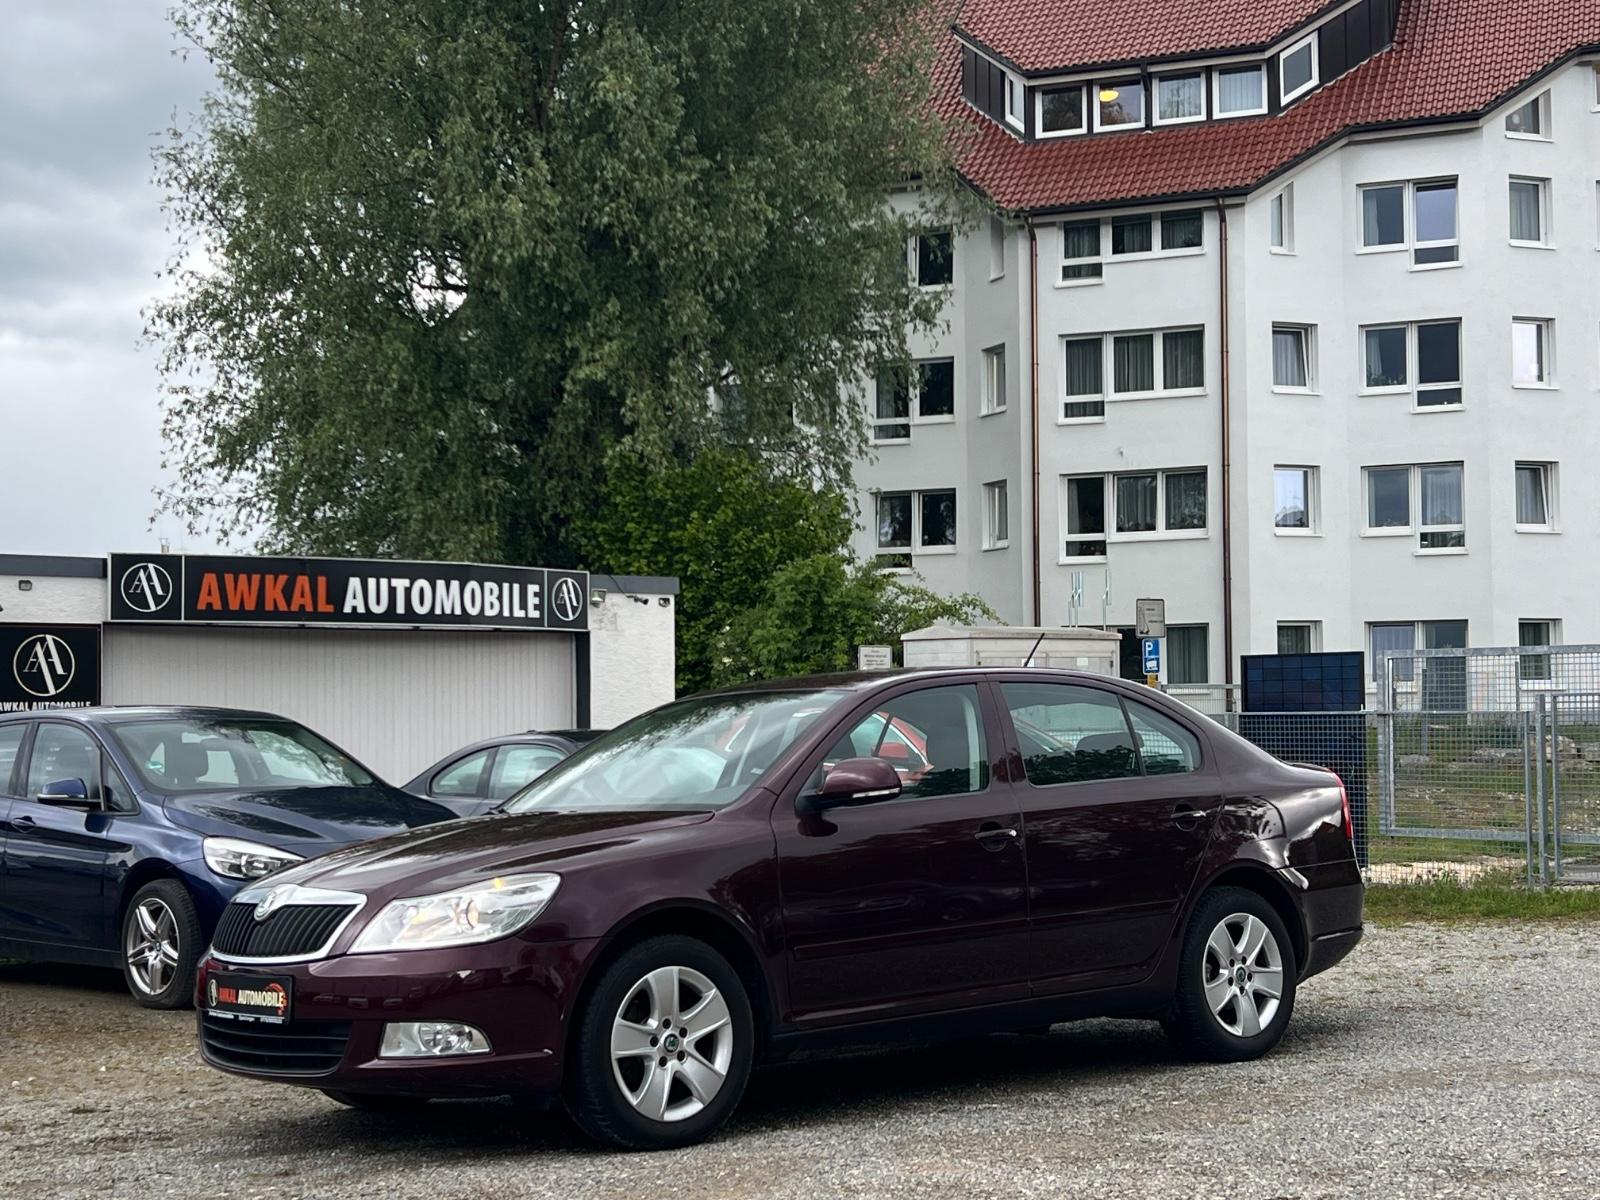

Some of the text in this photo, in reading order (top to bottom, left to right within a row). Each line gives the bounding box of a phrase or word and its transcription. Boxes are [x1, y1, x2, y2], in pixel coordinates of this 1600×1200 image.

[196, 572, 541, 619] AWKAL AUTOMOBILE
[1145, 641, 1154, 657] P
[0, 701, 31, 712] AWKAL
[237, 989, 285, 1008] AUTOMOBILE
